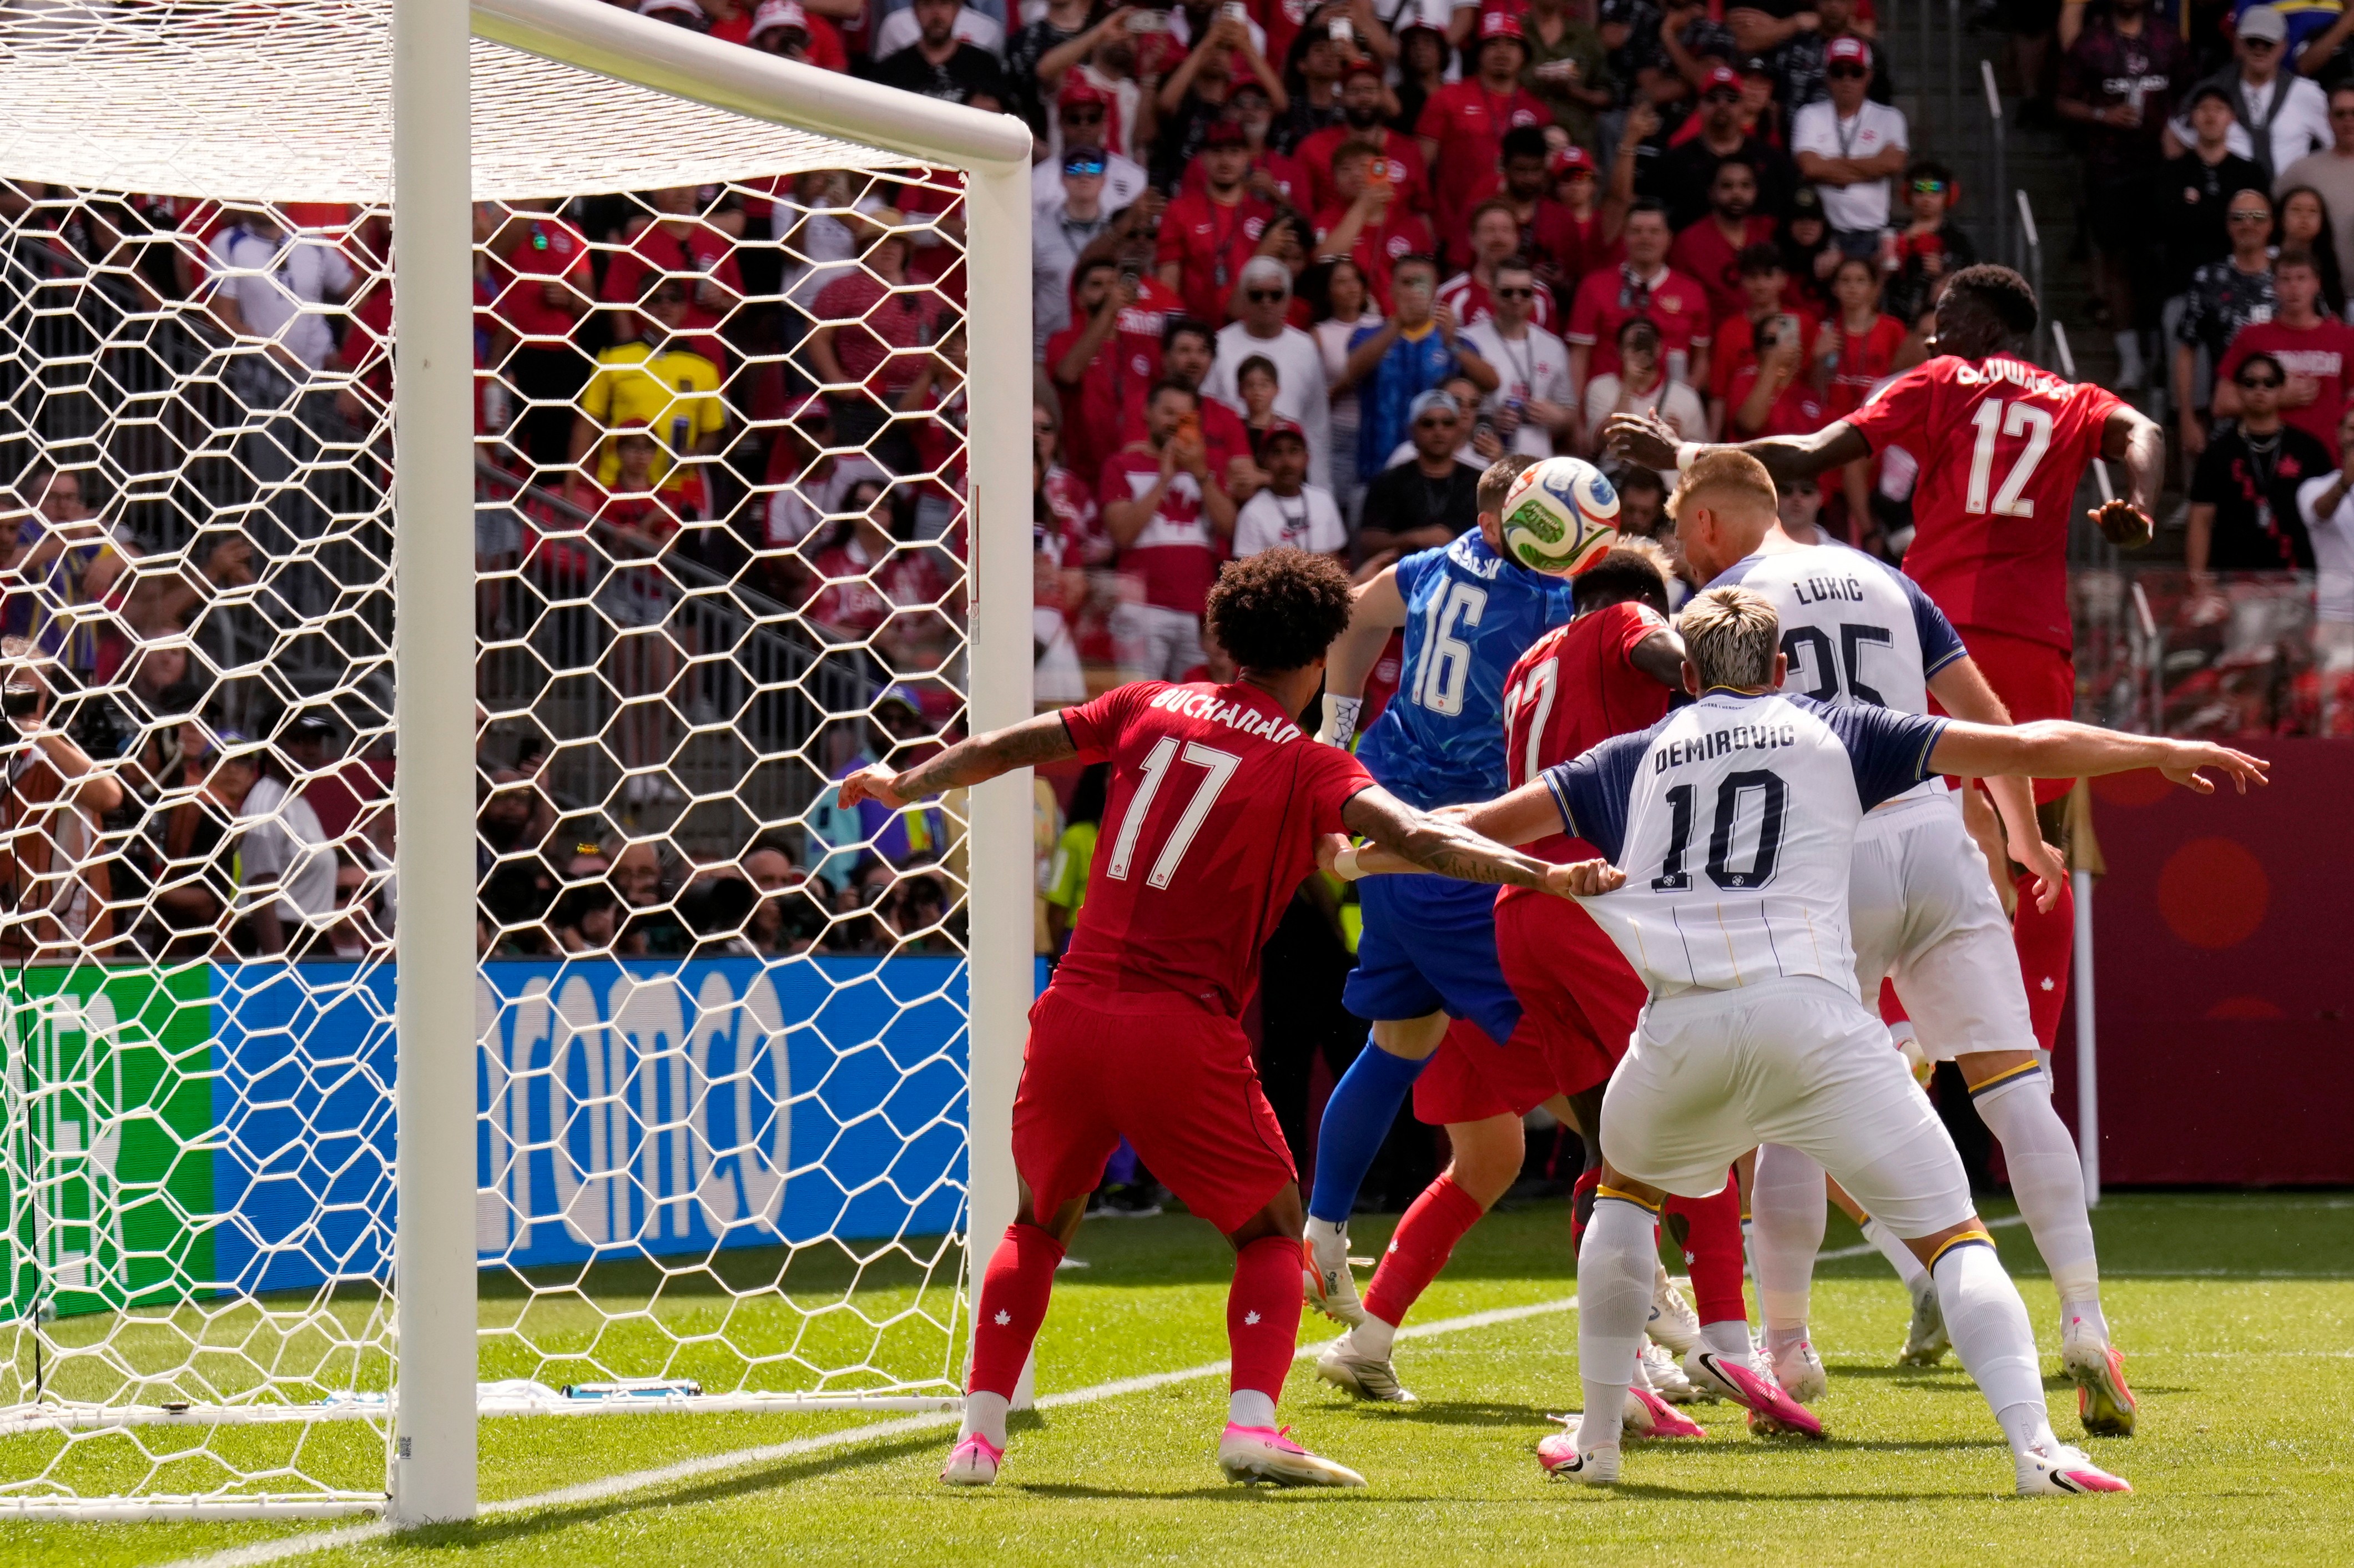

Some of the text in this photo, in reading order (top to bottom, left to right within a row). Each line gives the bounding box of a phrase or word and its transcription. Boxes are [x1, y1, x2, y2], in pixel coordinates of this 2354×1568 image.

[1965, 397, 2054, 518] 12
[1412, 574, 1488, 717] 16
[1779, 623, 1894, 709] 25
[1150, 688, 1302, 744] BUCHANAN
[1106, 736, 1243, 890] 17
[1651, 769, 1789, 893] 10
